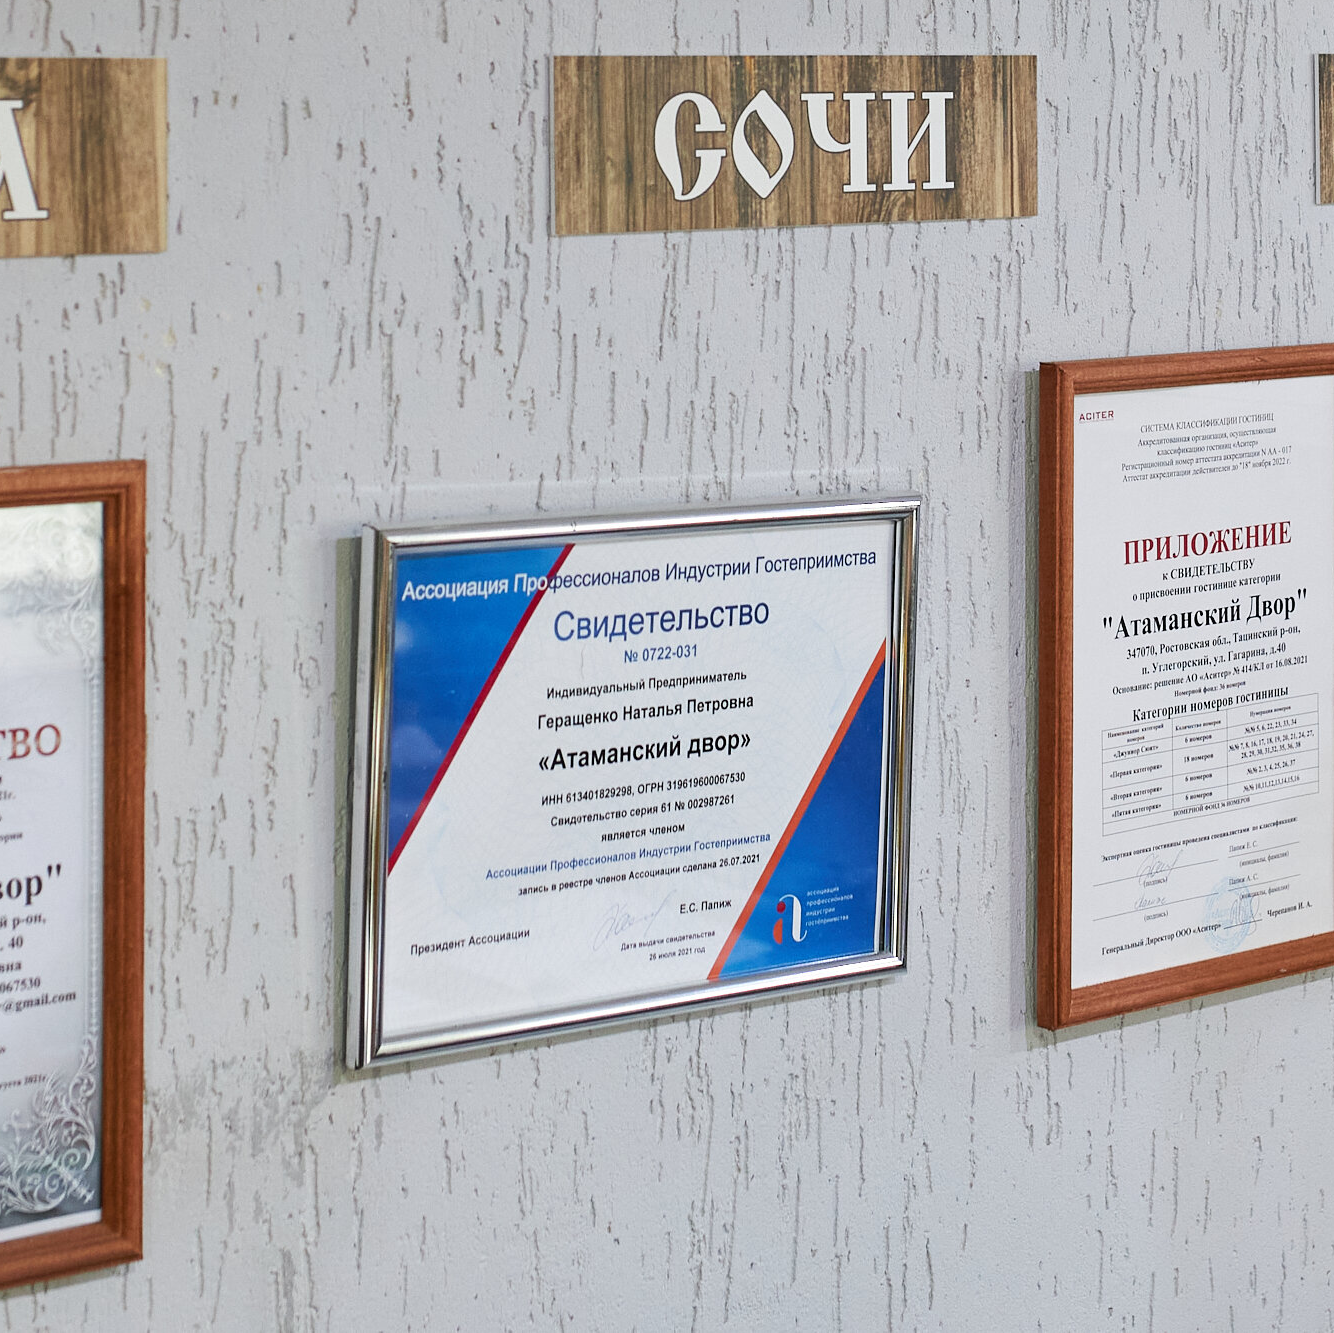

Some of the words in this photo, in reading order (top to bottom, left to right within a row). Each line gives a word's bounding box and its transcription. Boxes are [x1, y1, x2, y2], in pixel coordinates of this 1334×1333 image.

[653, 89, 956, 202] СОЧИ
[1079, 411, 1114, 421] ACITER
[1141, 423, 1175, 433] СИСТЕМА
[1124, 521, 1291, 565] ПРИЛОЖЕНИЕ
[401, 579, 509, 602] Ассоциация
[513, 568, 660, 595] Профессионалов
[666, 559, 751, 584] Индустрии
[755, 550, 877, 575] Гостеприимства
[1170, 559, 1255, 580] СВИДЕТЕЛЬСТВУ
[1140, 587, 1191, 602] присвоении
[1194, 581, 1237, 593] гостинице
[1239, 573, 1281, 588] категории
[553, 602, 769, 642] Свидетельство
[1102, 598, 1241, 639] "Атаманский
[1246, 588, 1307, 625] Двор"
[624, 647, 638, 663] №
[642, 644, 698, 661] 0722-031
[1126, 647, 1158, 660] 347070,
[1160, 638, 1210, 655] Ростовская
[1233, 627, 1278, 643] Тацинский
[1152, 655, 1212, 674] Углегорский,
[1228, 647, 1268, 662] Гагарина,
[547, 678, 645, 699] Индивидуальный
[648, 671, 747, 690] Предприниматель
[538, 708, 618, 731] Геращенко
[623, 703, 682, 721] Наталья
[687, 696, 754, 715] Петровна
[1133, 704, 1187, 722] Категории
[1190, 694, 1233, 712] номеров
[1236, 686, 1289, 705] гостиницы
[539, 735, 681, 771] «Атаманский
[687, 732, 751, 758] двор»
[541, 793, 563, 807] ИНН
[566, 785, 635, 803] 613401829298,
[637, 781, 664, 794] ОГРН
[667, 771, 746, 791] 319619600067530
[550, 808, 627, 827] Свидетельство
[630, 805, 658, 818] серия
[661, 802, 672, 812] 61
[687, 794, 735, 810] 002987261
[601, 828, 646, 842] является
[649, 824, 685, 836] членом
[485, 863, 547, 880] Ассоциации
[550, 849, 636, 872] Профессионалов
[639, 843, 692, 859] Индустрии
[694, 832, 771, 851] Гостеприимства
[679, 903, 699, 914] Е.С.
[701, 899, 732, 912] Папиж
[410, 939, 465, 956] Президент
[468, 928, 531, 947] Ассоциации
[1102, 938, 1144, 956] Генеральный
[1145, 932, 1175, 947] Директор
[1176, 928, 1192, 938] ООО
